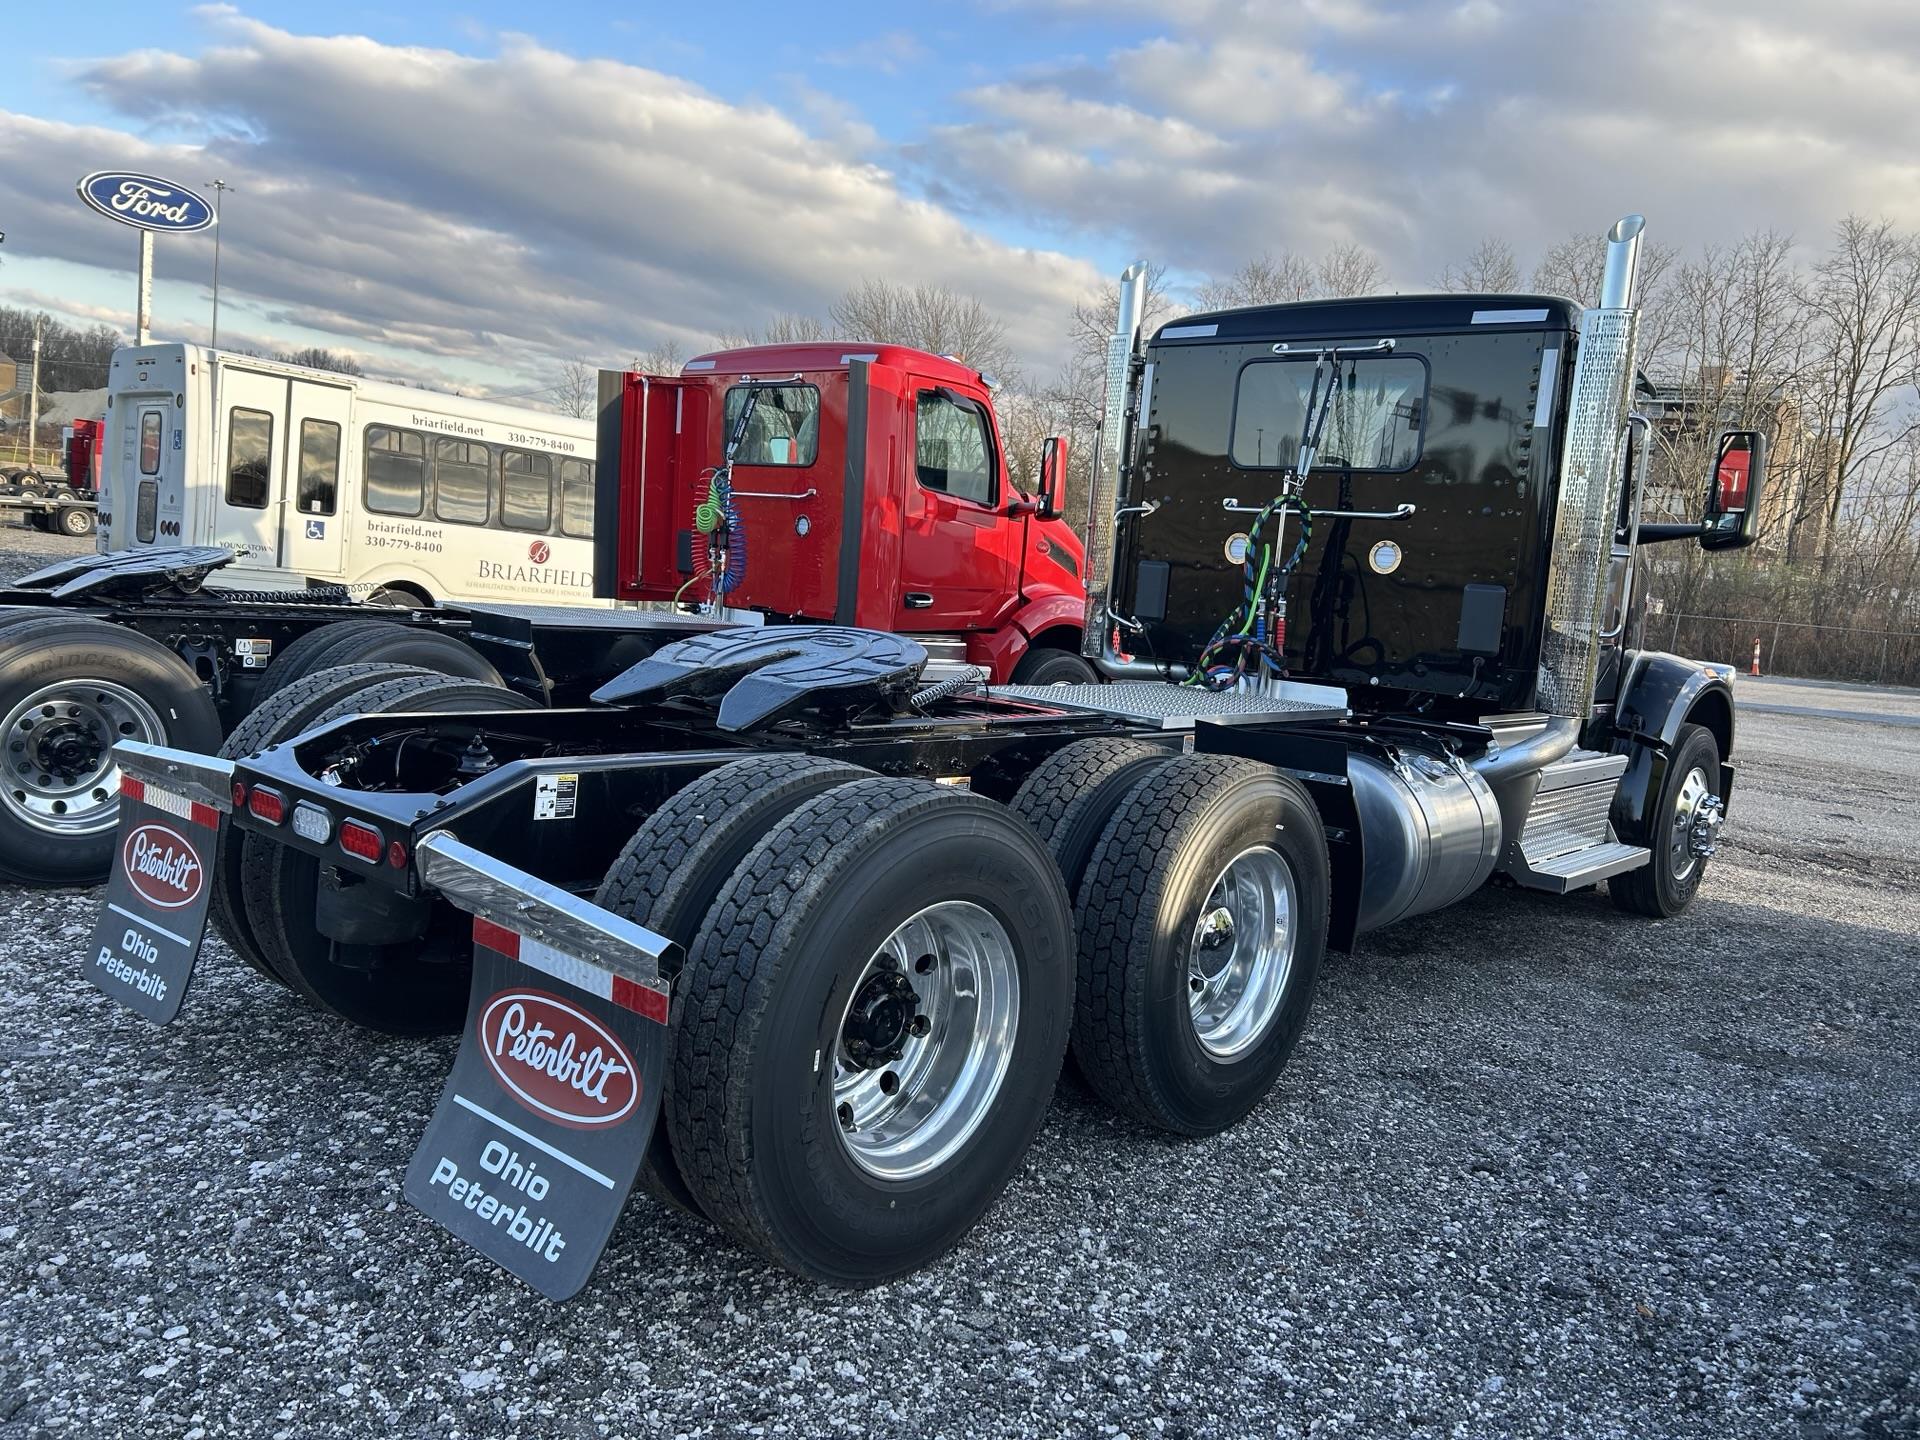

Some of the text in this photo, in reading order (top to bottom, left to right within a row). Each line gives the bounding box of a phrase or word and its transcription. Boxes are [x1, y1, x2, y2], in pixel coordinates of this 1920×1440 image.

[111, 182, 190, 222] Ford
[412, 414, 575, 452] briarfield.net 330-779-8400
[219, 540, 274, 552] YOUNGSTOWN
[365, 536, 442, 553] 330-779-8400
[367, 520, 442, 538] briarfield.net
[479, 559, 593, 588] BRIARFIELD
[131, 832, 198, 892] Peterbilt
[121, 929, 158, 964] Ohio
[96, 946, 167, 1001] Peterbilt
[495, 1002, 627, 1104] Peterbilt
[479, 1140, 550, 1202] Ohio
[429, 1156, 566, 1263] Peterbilt
